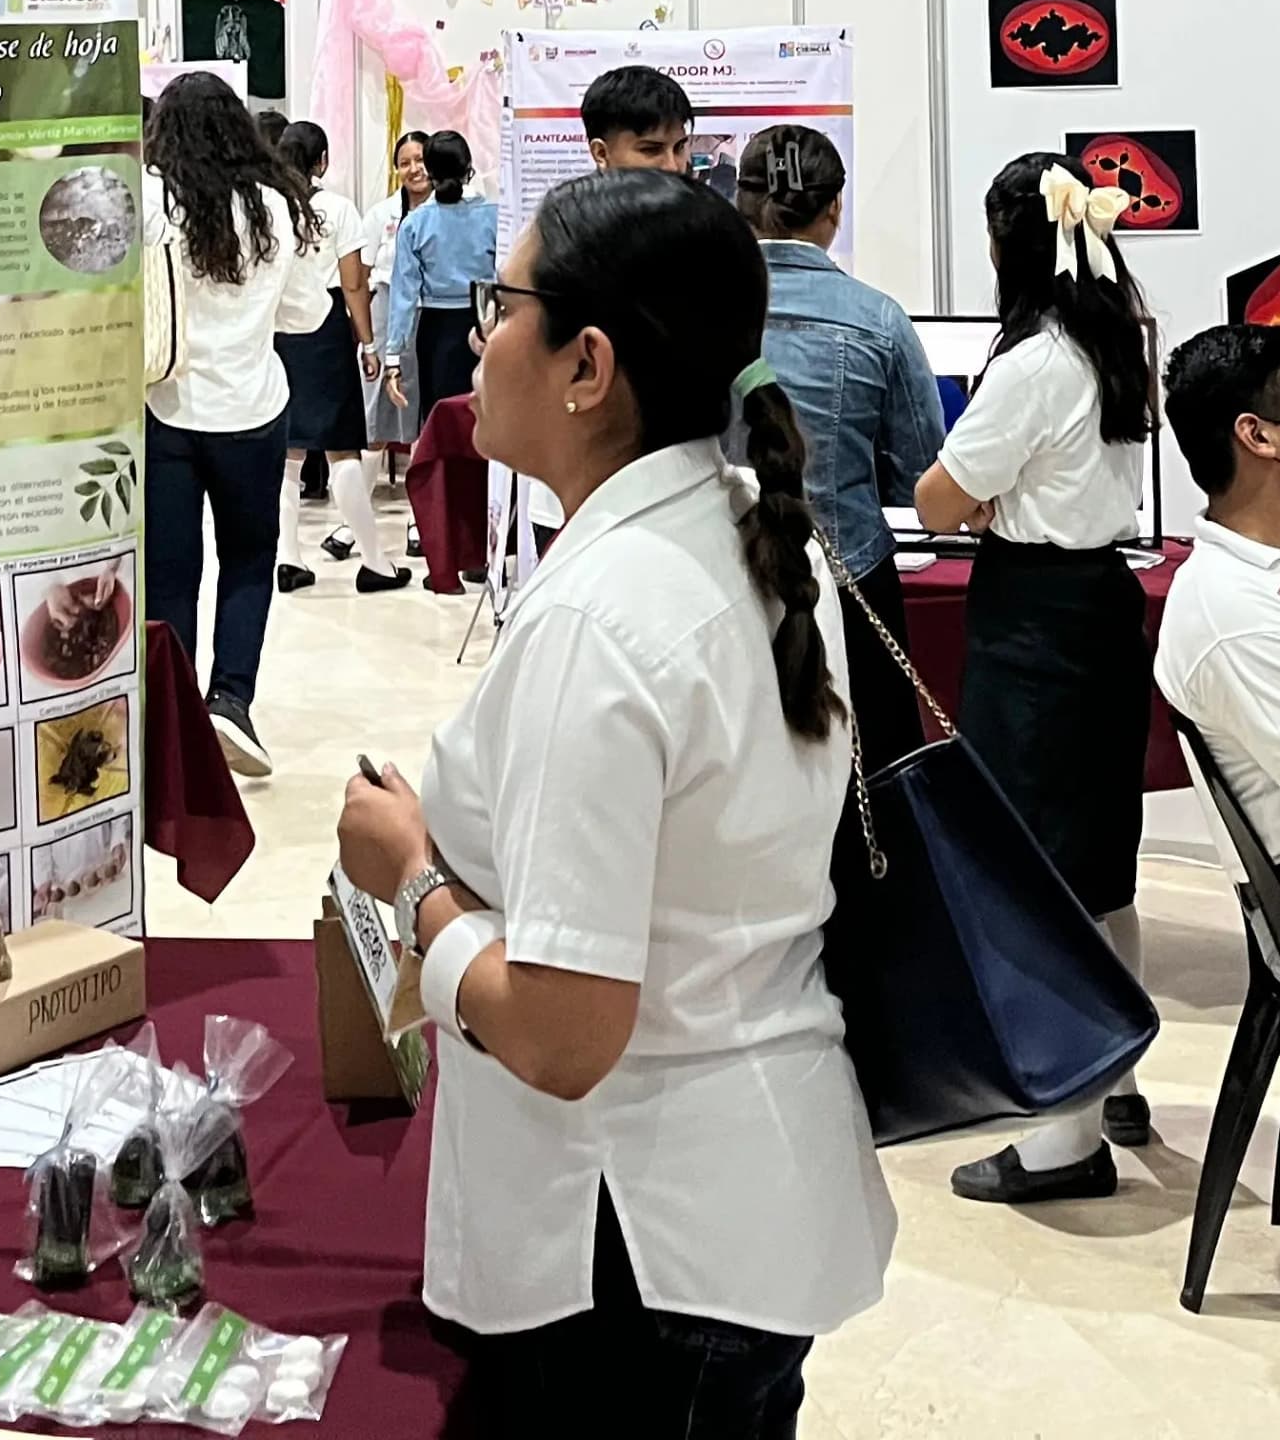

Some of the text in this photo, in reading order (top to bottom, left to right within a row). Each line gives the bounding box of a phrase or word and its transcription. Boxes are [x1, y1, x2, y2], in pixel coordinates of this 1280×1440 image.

[29, 35, 53, 59] de
[63, 31, 118, 64] hoja
[29, 963, 122, 1034] PROTOTIPO
